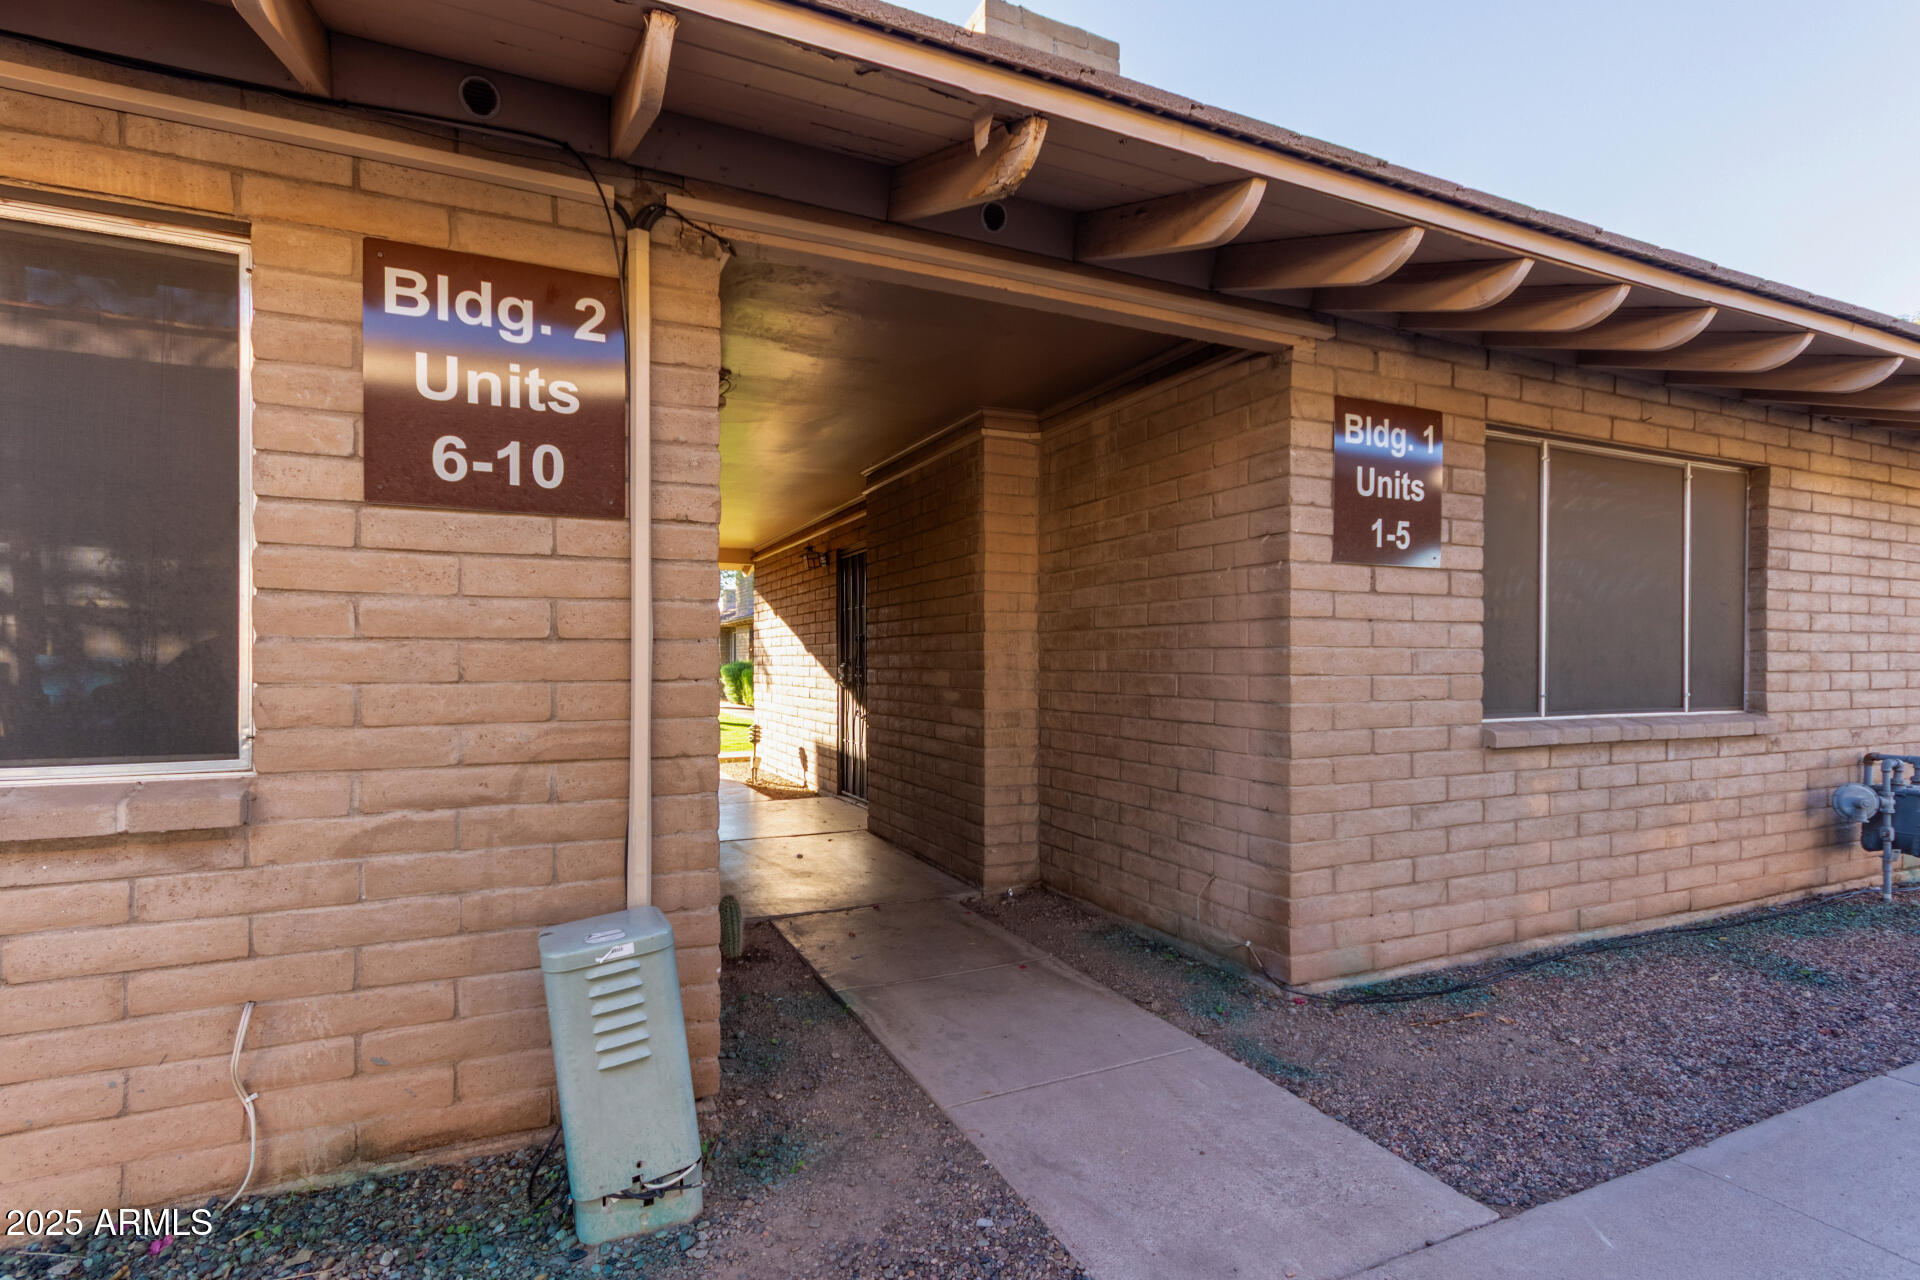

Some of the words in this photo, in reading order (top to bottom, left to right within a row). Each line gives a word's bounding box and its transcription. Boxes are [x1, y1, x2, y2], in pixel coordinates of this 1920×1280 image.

[384, 266, 552, 344] Bldg.
[573, 297, 606, 343] 2
[415, 351, 580, 415] Units
[1344, 413, 1414, 458] Bldg.
[1423, 424, 1435, 454] 1
[432, 435, 564, 489] 6-10
[1356, 465, 1425, 502] Units
[1371, 518, 1411, 550] 1-5
